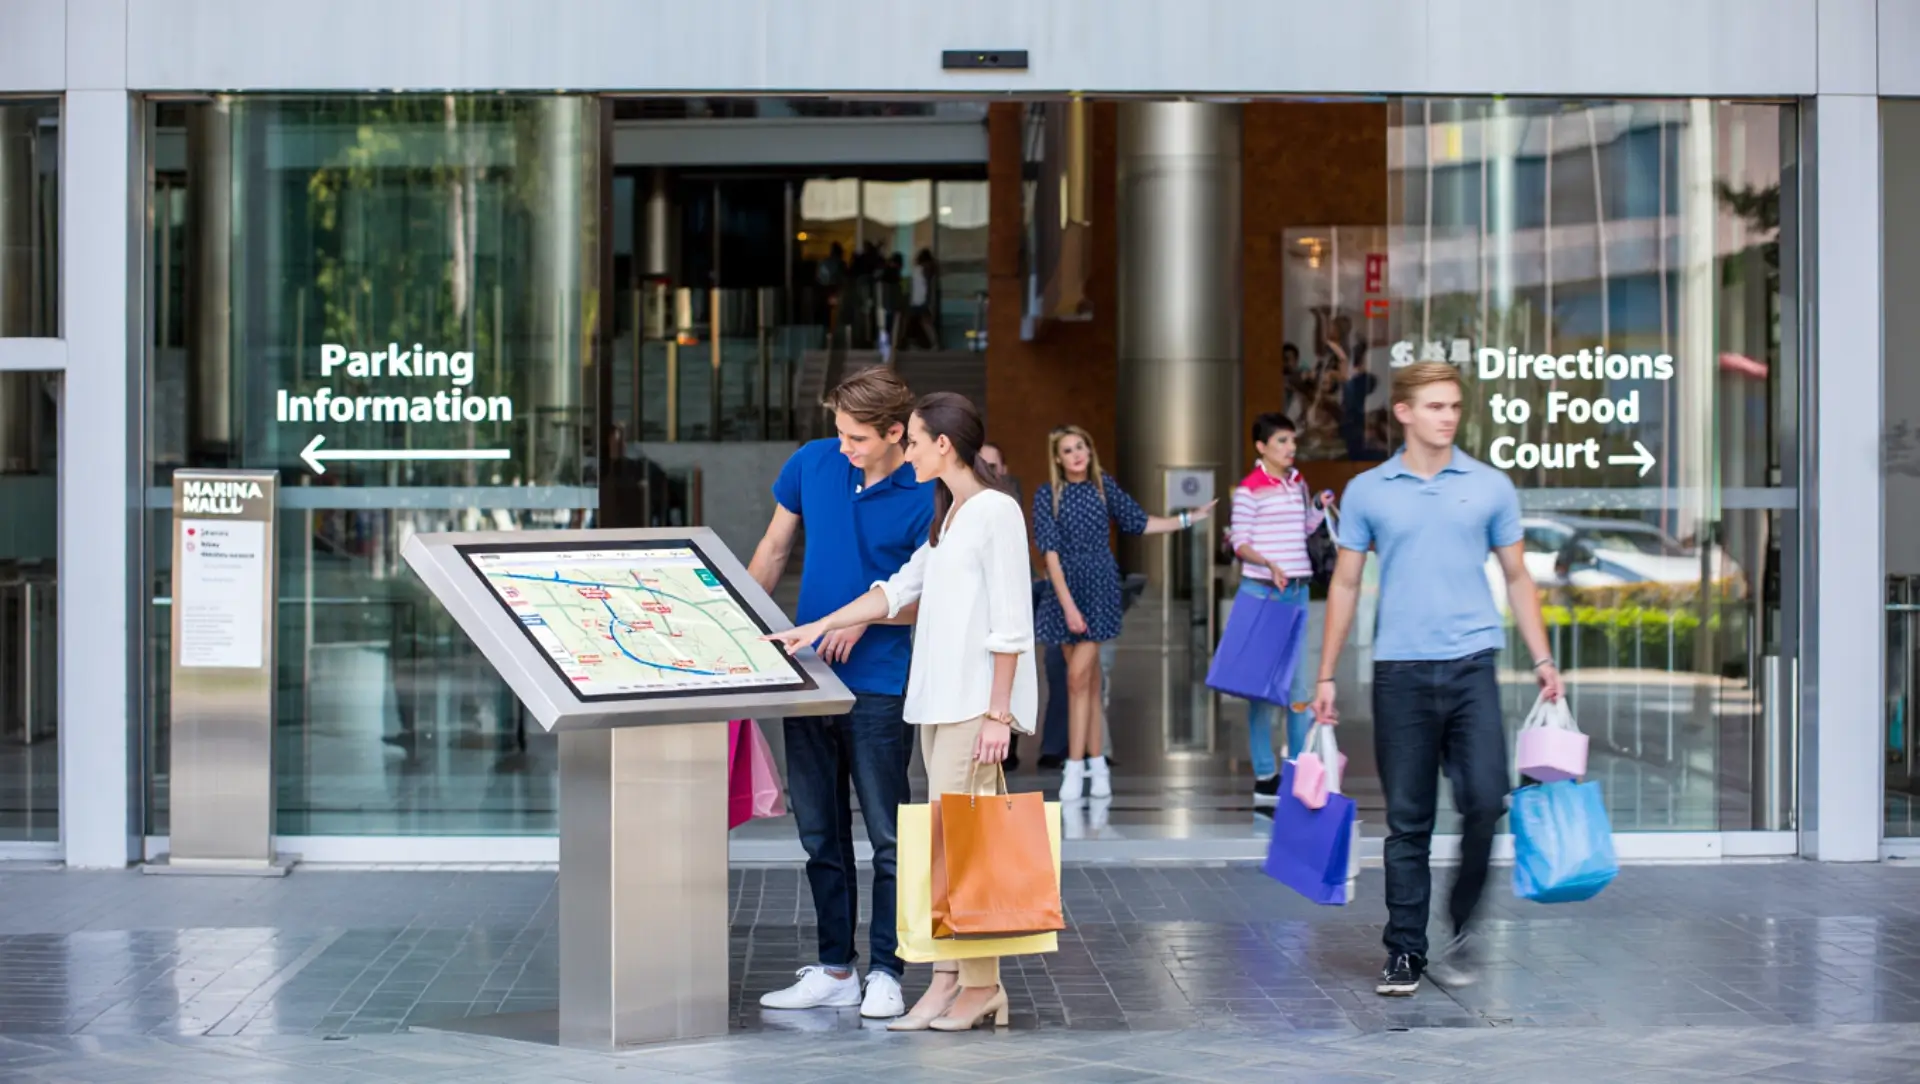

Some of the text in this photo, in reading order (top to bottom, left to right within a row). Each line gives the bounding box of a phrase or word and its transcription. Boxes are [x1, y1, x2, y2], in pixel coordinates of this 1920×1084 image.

[320, 342, 475, 386] Parking
[1477, 346, 1674, 380] Directions
[276, 387, 513, 422] Information
[1489, 389, 1640, 424] to Food
[1489, 435, 1600, 470] Court
[182, 480, 264, 499] MARINA
